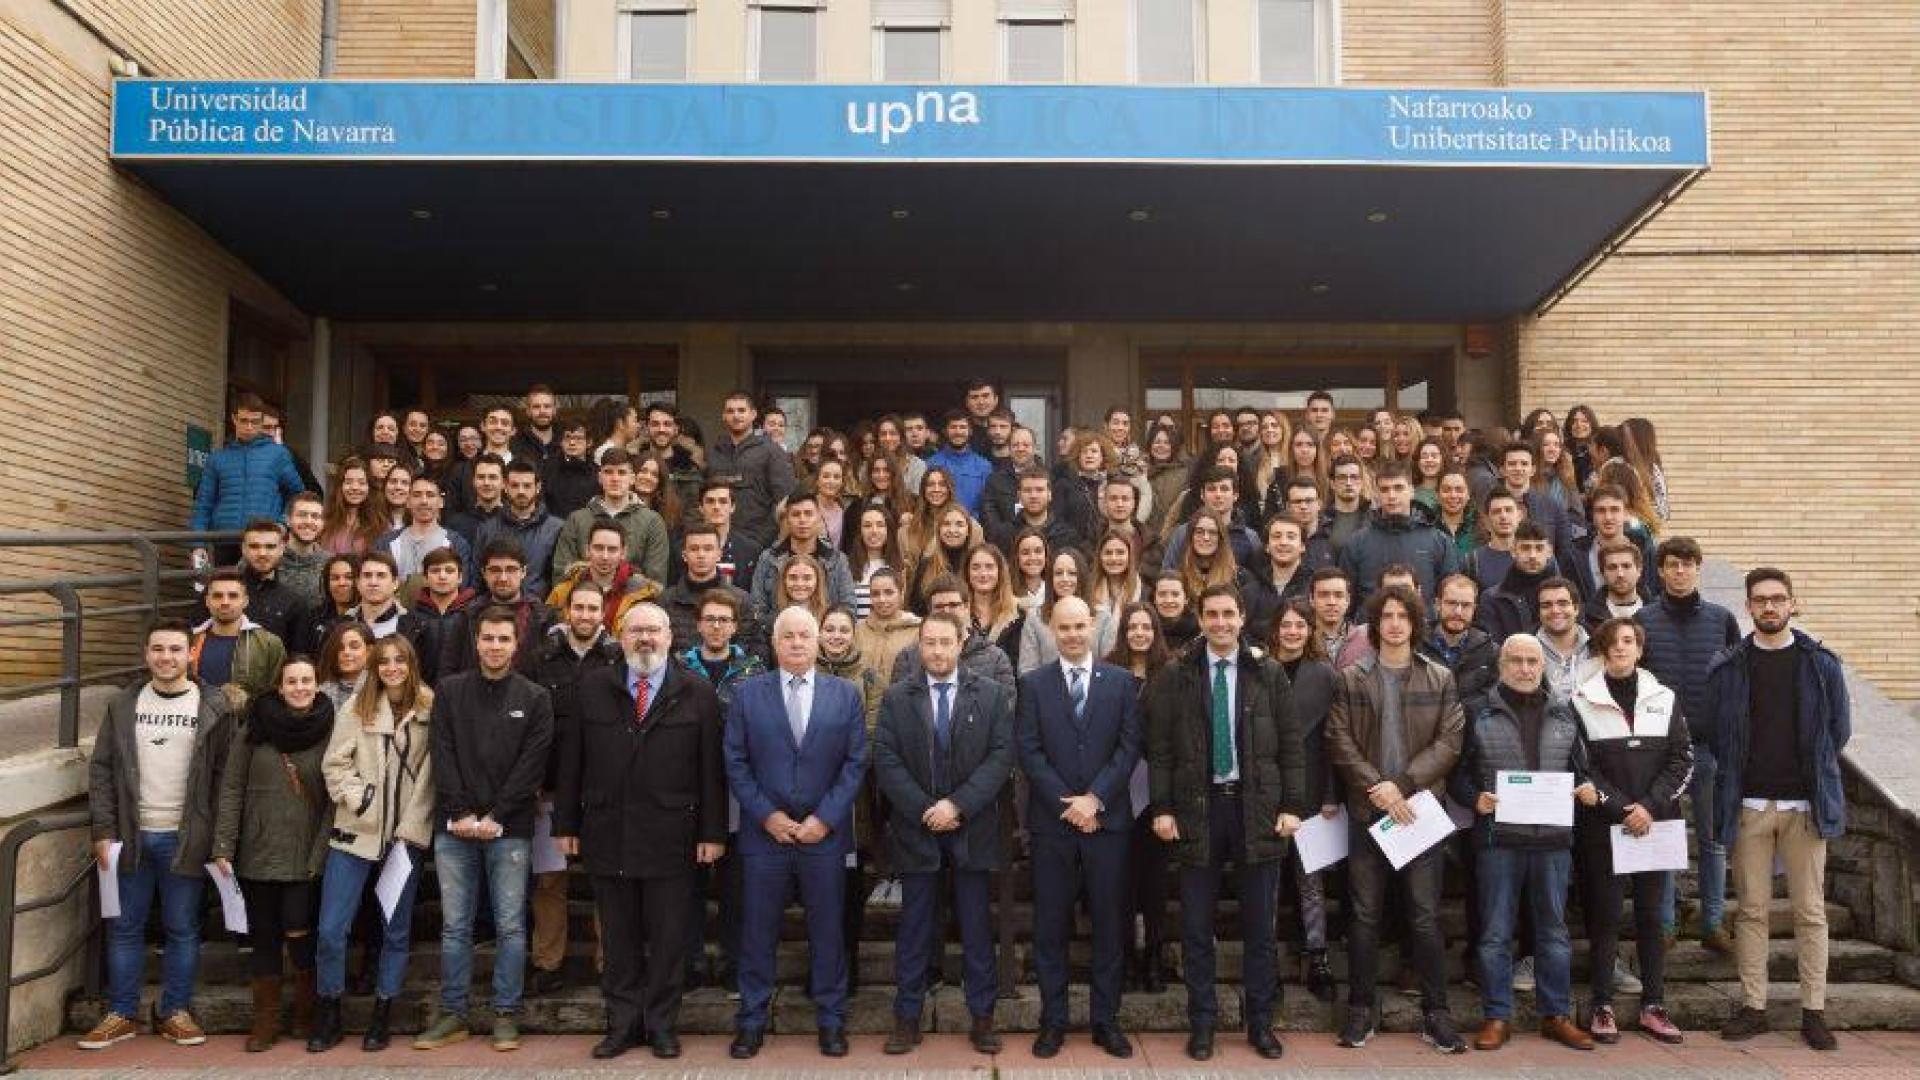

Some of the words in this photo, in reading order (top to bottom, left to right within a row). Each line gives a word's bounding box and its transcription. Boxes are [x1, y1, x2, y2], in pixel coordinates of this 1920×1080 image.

[148, 87, 308, 112] Universidad
[1388, 94, 1533, 121] Nafarroako
[149, 118, 246, 142] Pública
[254, 118, 284, 142] de
[292, 119, 396, 143] Navarra
[847, 91, 979, 144] upna
[1387, 125, 1552, 151] Unibertsitate
[1560, 126, 1672, 152] Publikoa
